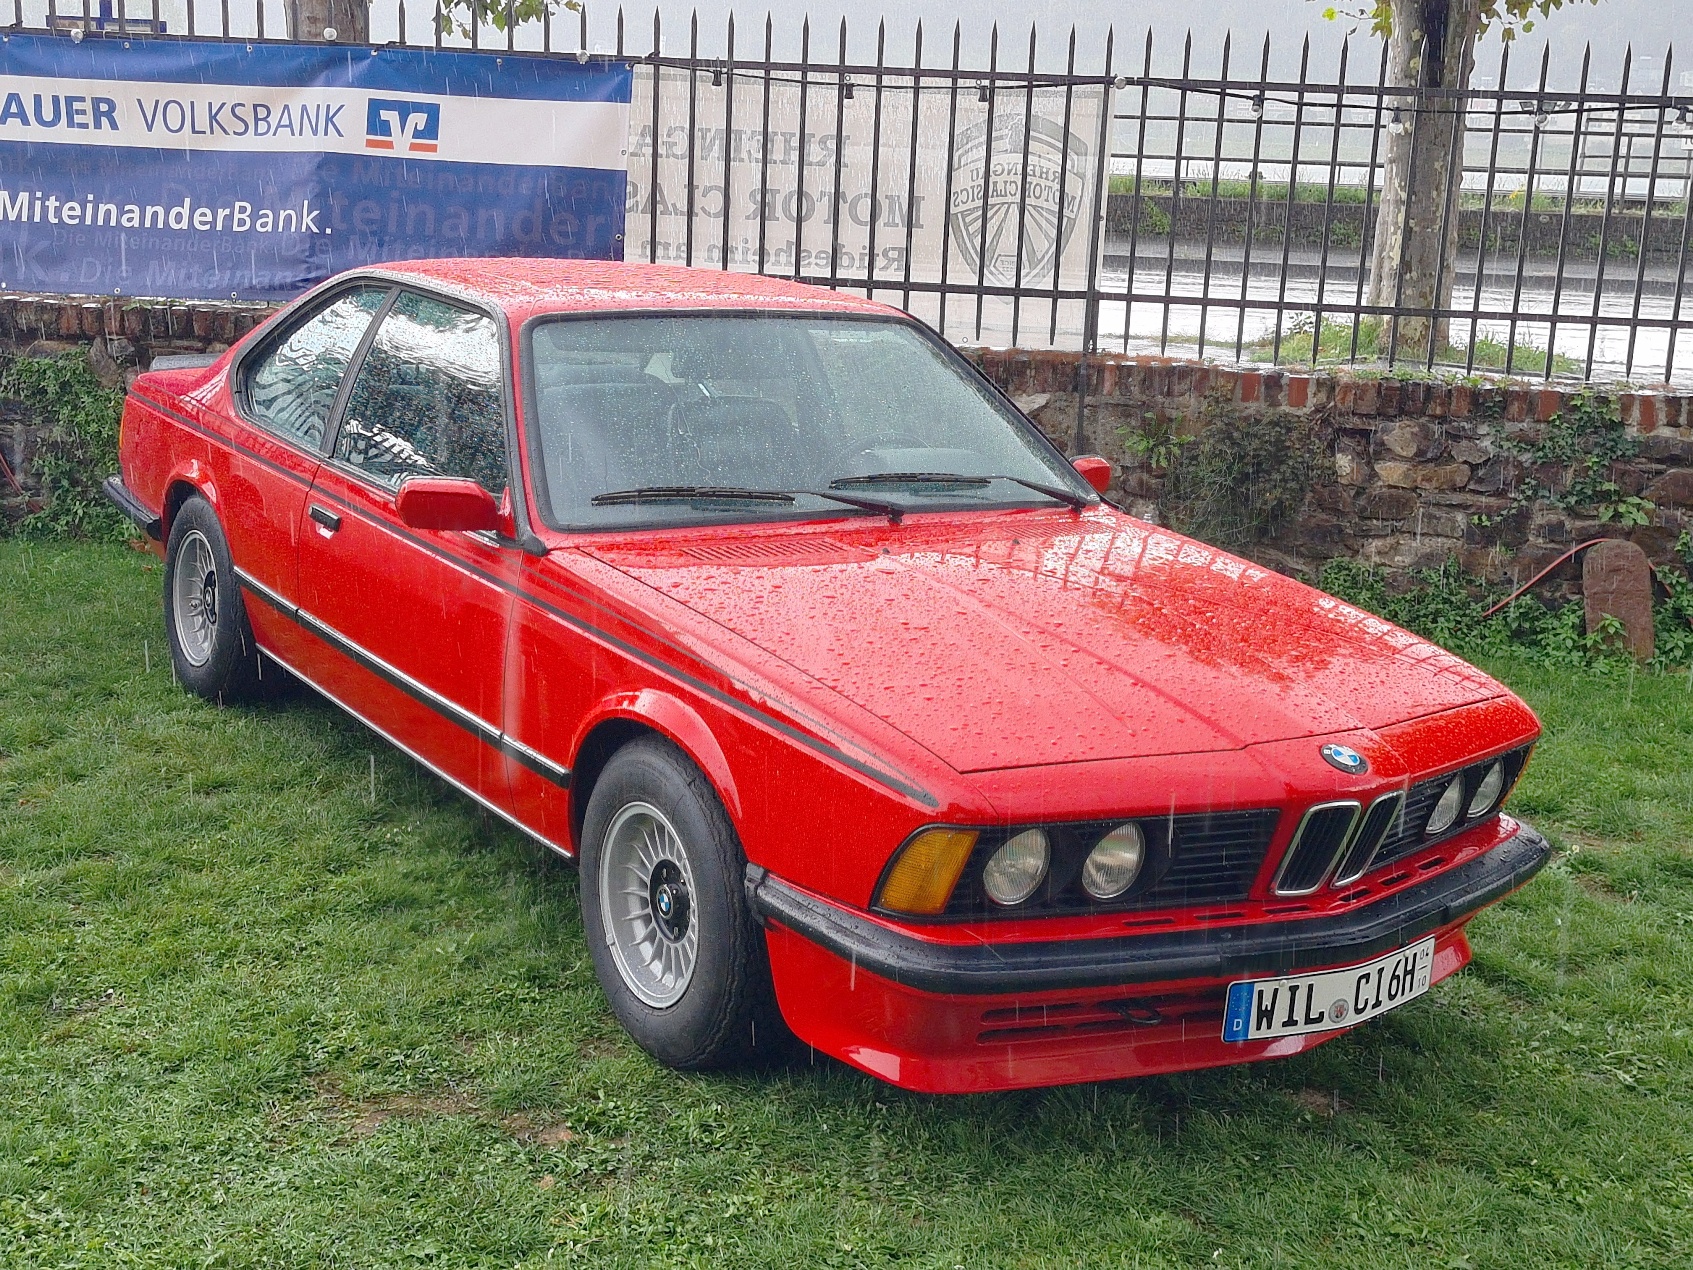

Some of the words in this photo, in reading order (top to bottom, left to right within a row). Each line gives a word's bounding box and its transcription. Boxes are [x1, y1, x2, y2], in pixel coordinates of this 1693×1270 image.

[0, 92, 120, 131] AUER
[136, 98, 346, 138] VOLKSBANK
[0, 190, 332, 234] MiteinanderBank.
[1233, 1018, 1243, 1031] D
[1255, 984, 1325, 1031] WIL
